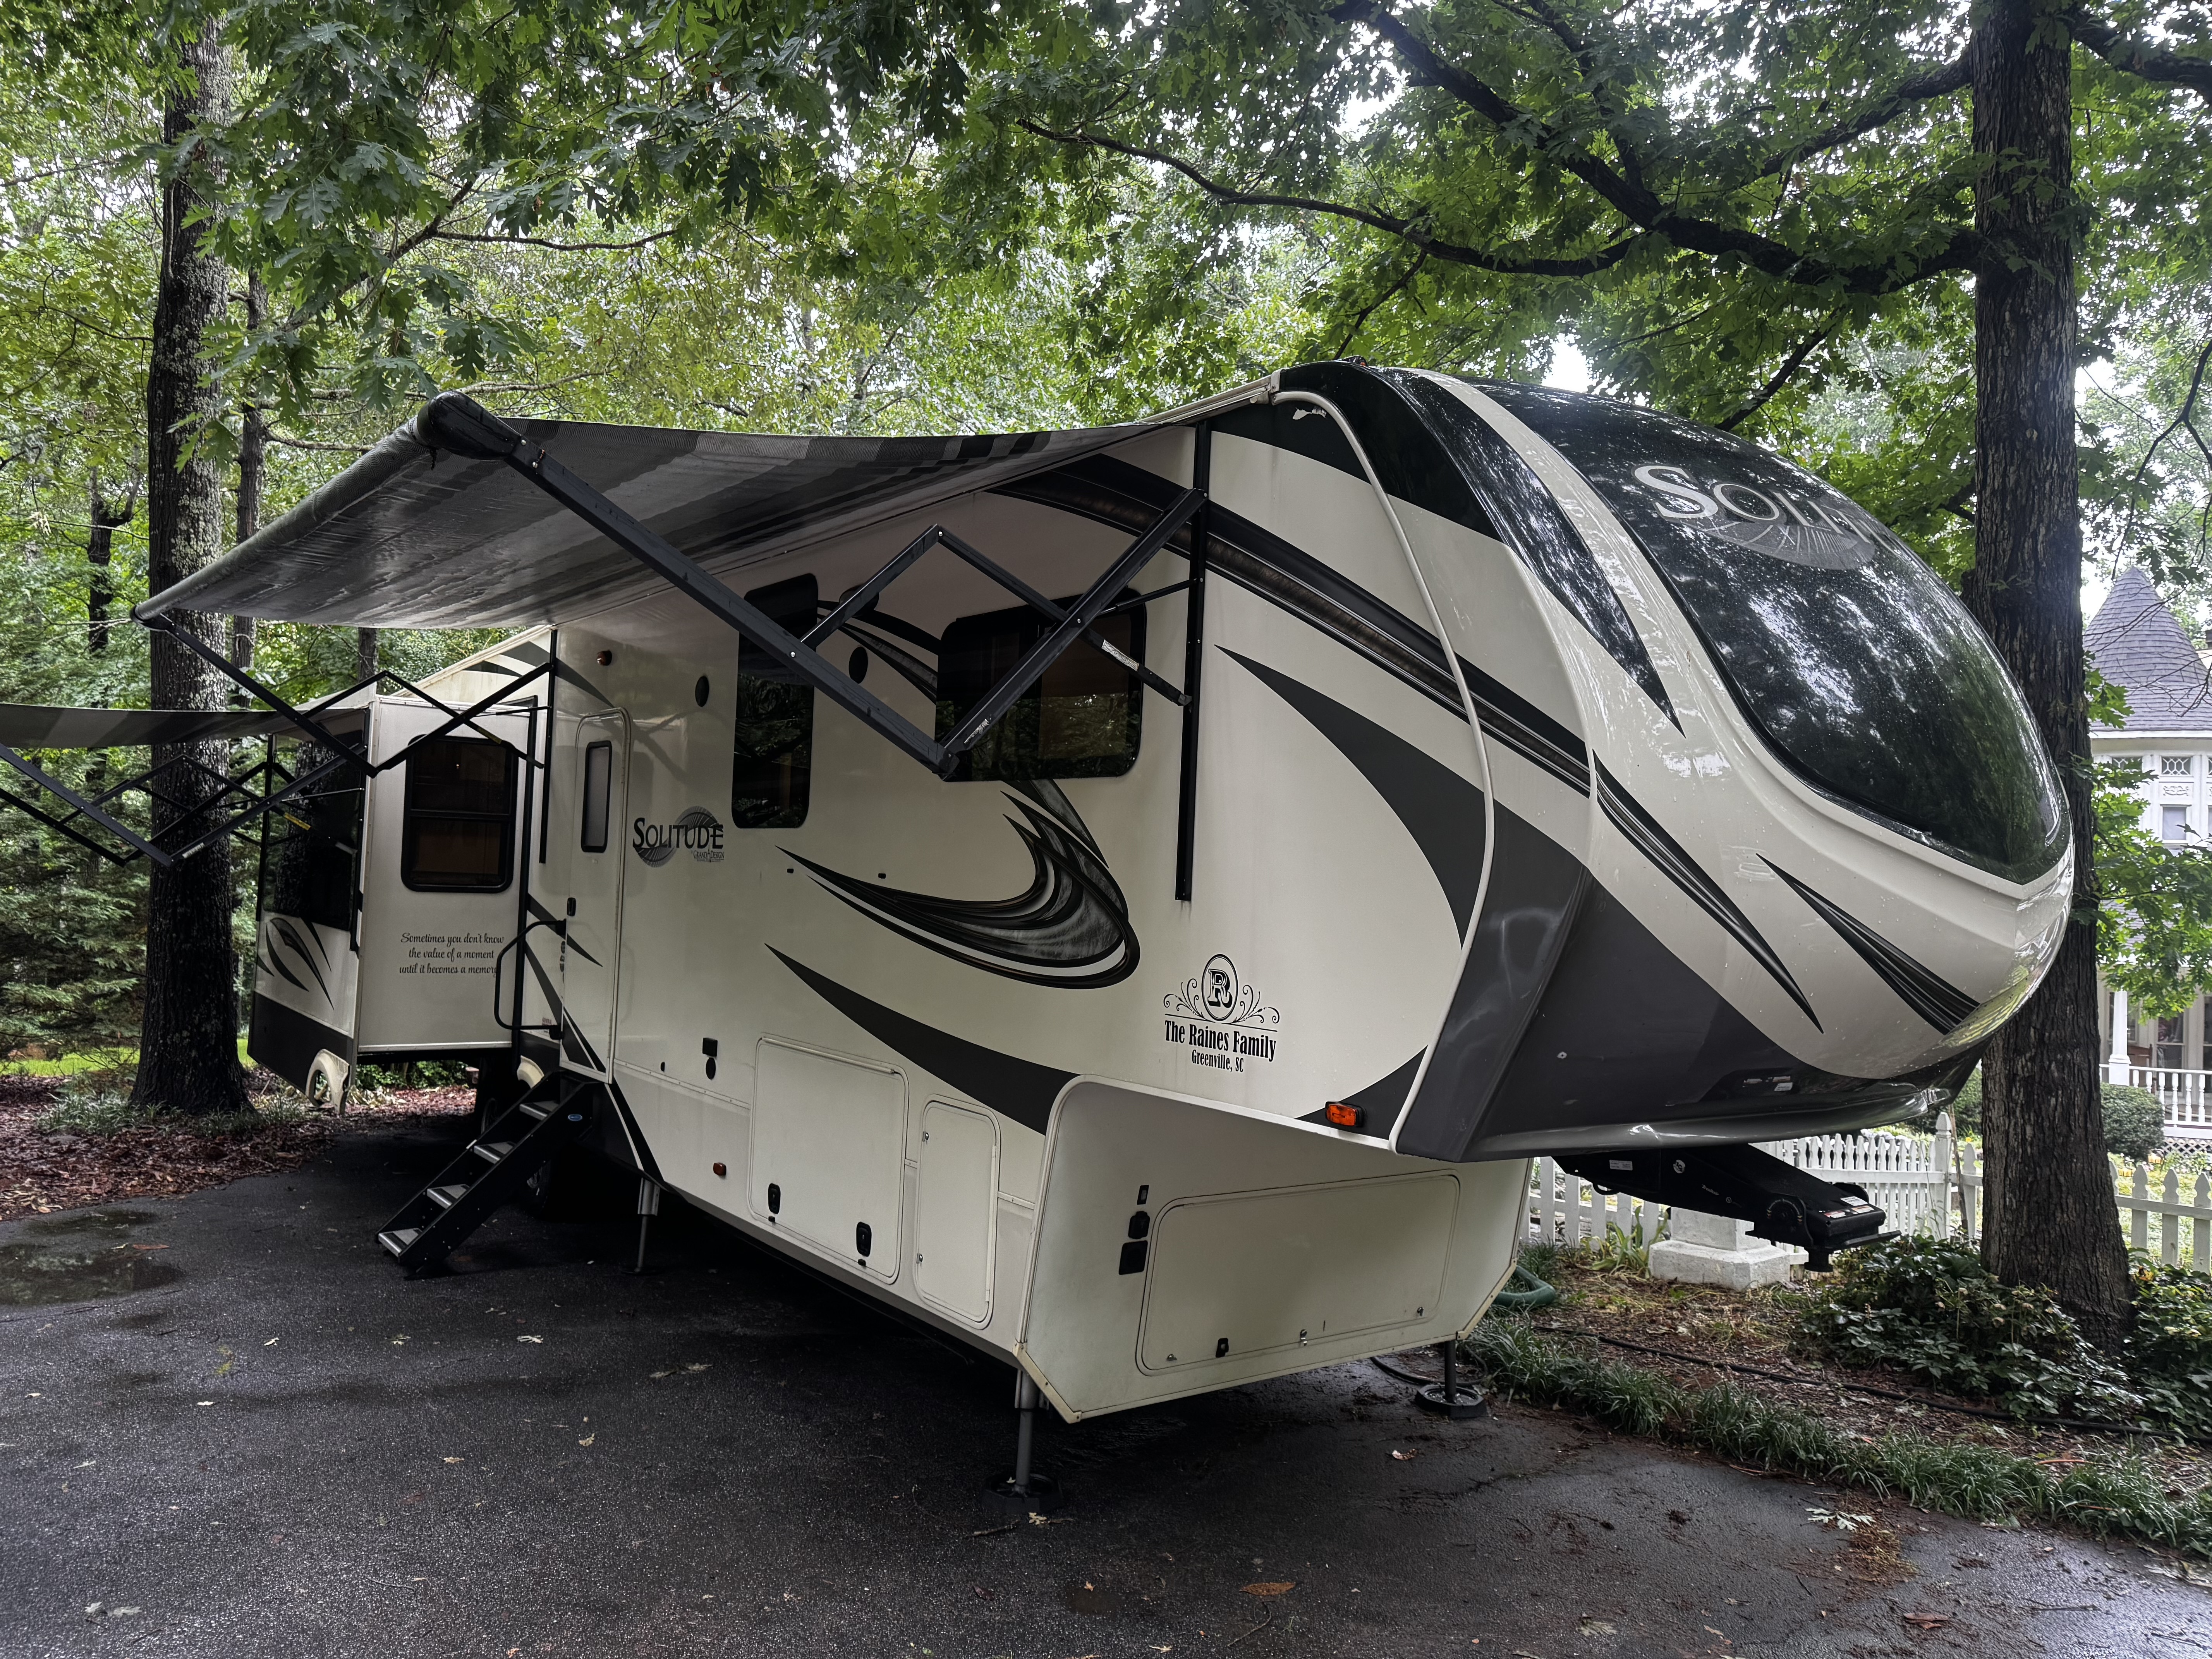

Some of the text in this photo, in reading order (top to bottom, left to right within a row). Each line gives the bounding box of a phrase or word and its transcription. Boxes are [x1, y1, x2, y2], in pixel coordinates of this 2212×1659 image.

[632, 817, 724, 849] SOLITUDE
[401, 933, 504, 947] Sometimes you don't know
[409, 947, 421, 958] the
[424, 947, 445, 958] value
[447, 948, 455, 962] of
[464, 950, 494, 958] moment
[399, 963, 418, 974] until
[419, 965, 425, 974] it
[427, 963, 458, 974] becomes
[1207, 968, 1233, 1008] R
[1165, 1020, 1276, 1062] The Raines Family
[1192, 1049, 1244, 1073] Greenville, SC
